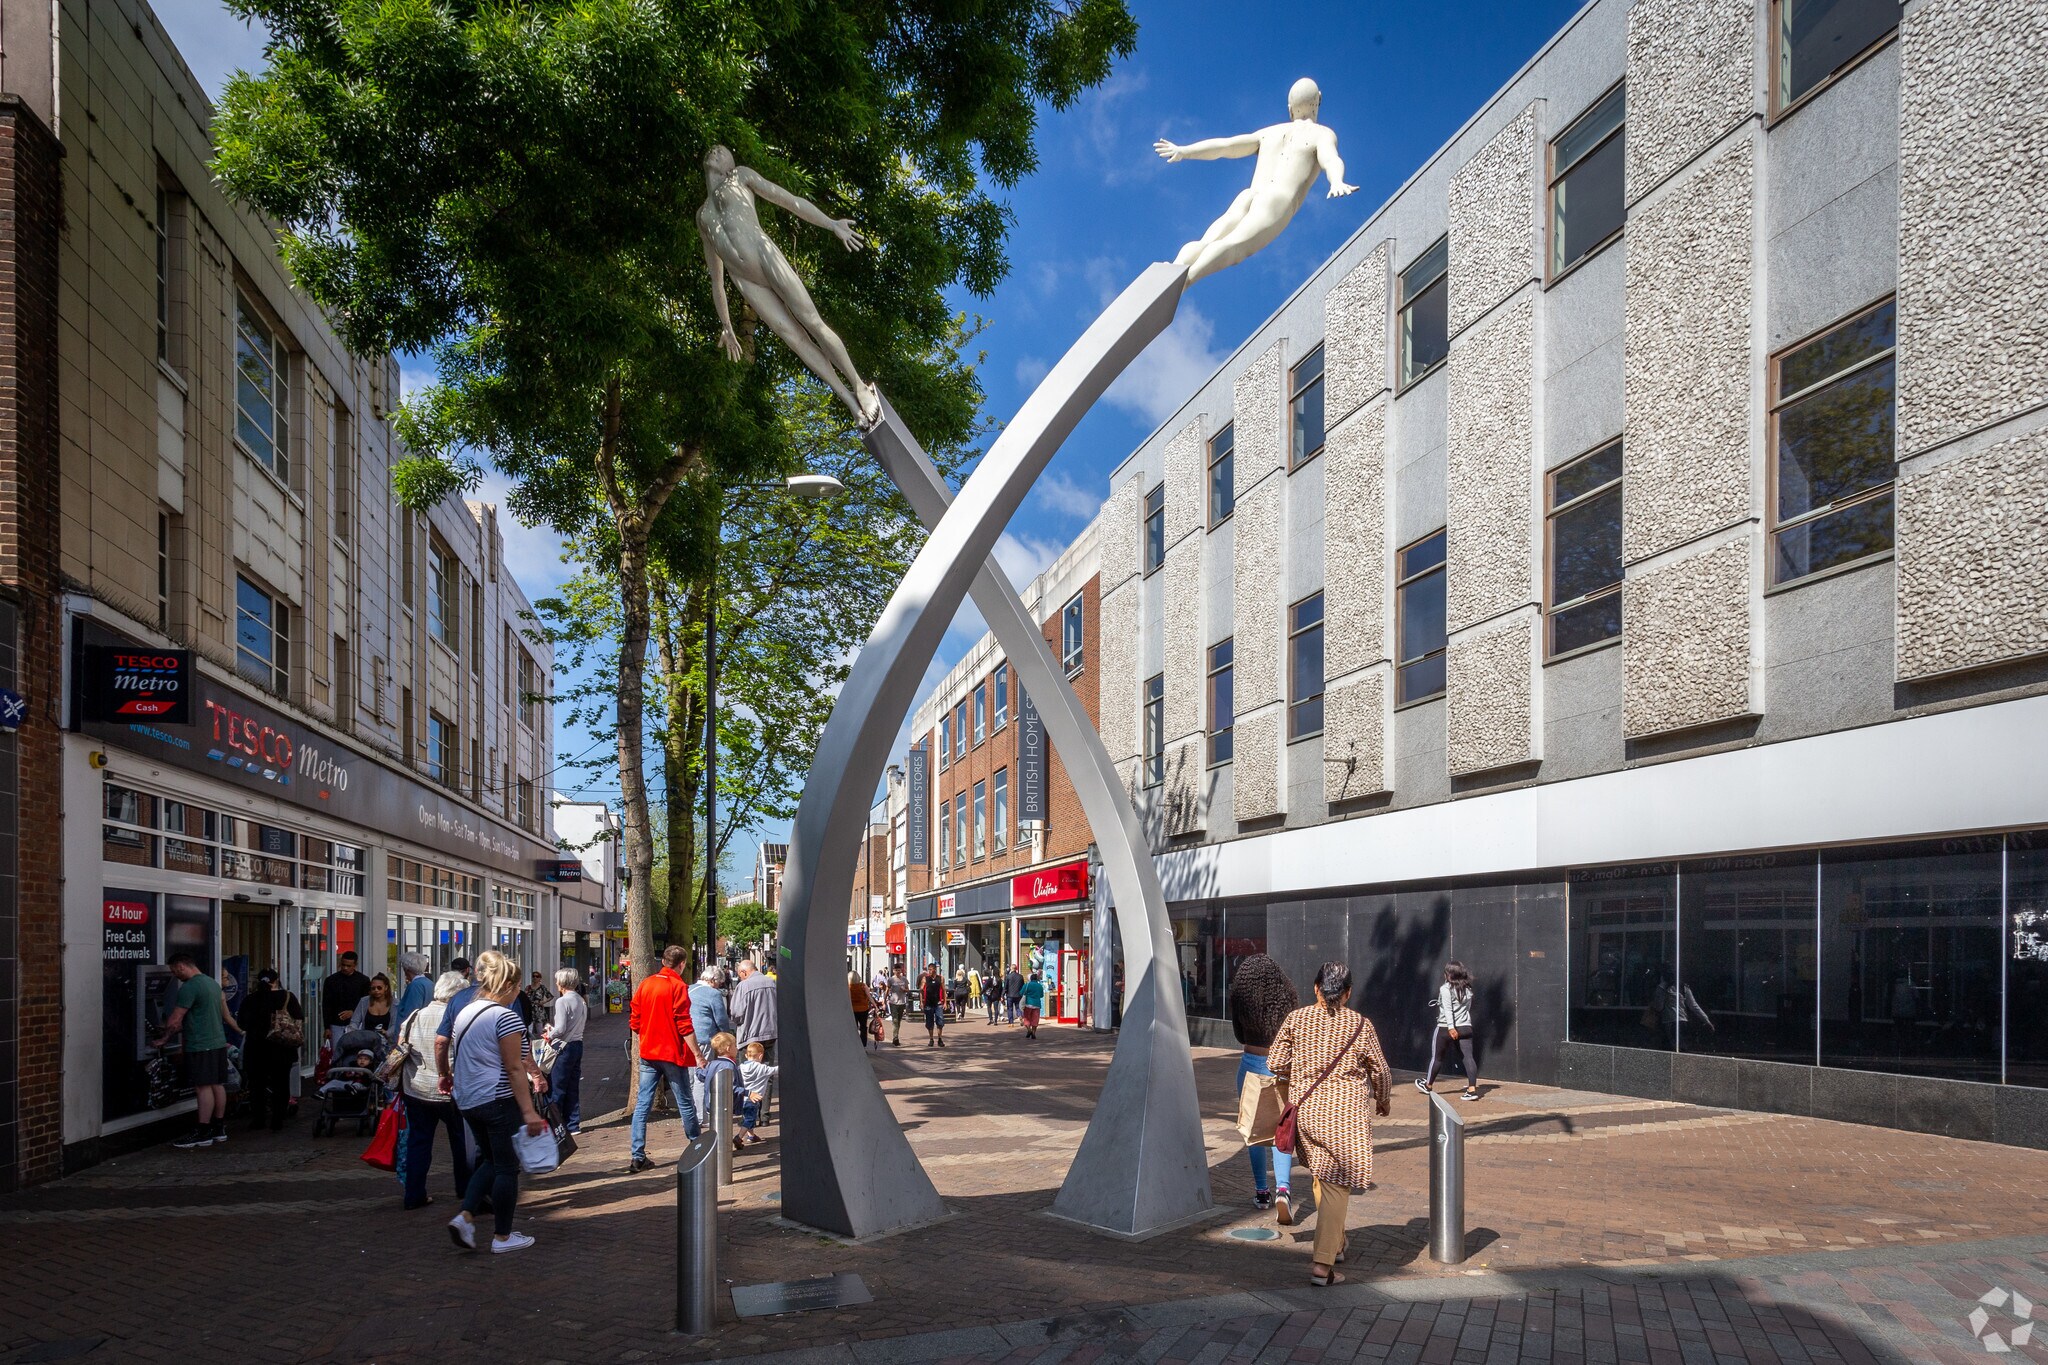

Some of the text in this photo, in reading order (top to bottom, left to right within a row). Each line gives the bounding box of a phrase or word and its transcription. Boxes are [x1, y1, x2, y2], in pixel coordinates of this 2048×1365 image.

[114, 655, 178, 668] TESCO
[114, 675, 178, 691] Metro
[135, 703, 158, 712] Cash
[129, 723, 190, 750] www.tesco.com
[1026, 713, 1038, 757] HOME
[206, 700, 348, 791] TESCO Metro
[1026, 761, 1038, 812] BRITISH
[914, 756, 923, 860] BRITISH HOME STORES
[419, 804, 436, 829] Open
[438, 812, 449, 833] Mon
[454, 820, 464, 839] Sat
[464, 823, 474, 843] 7am
[168, 846, 212, 866] Welcome to
[264, 861, 289, 878] Metro
[108, 905, 143, 919] 24 hour
[105, 929, 146, 943] Free Cash
